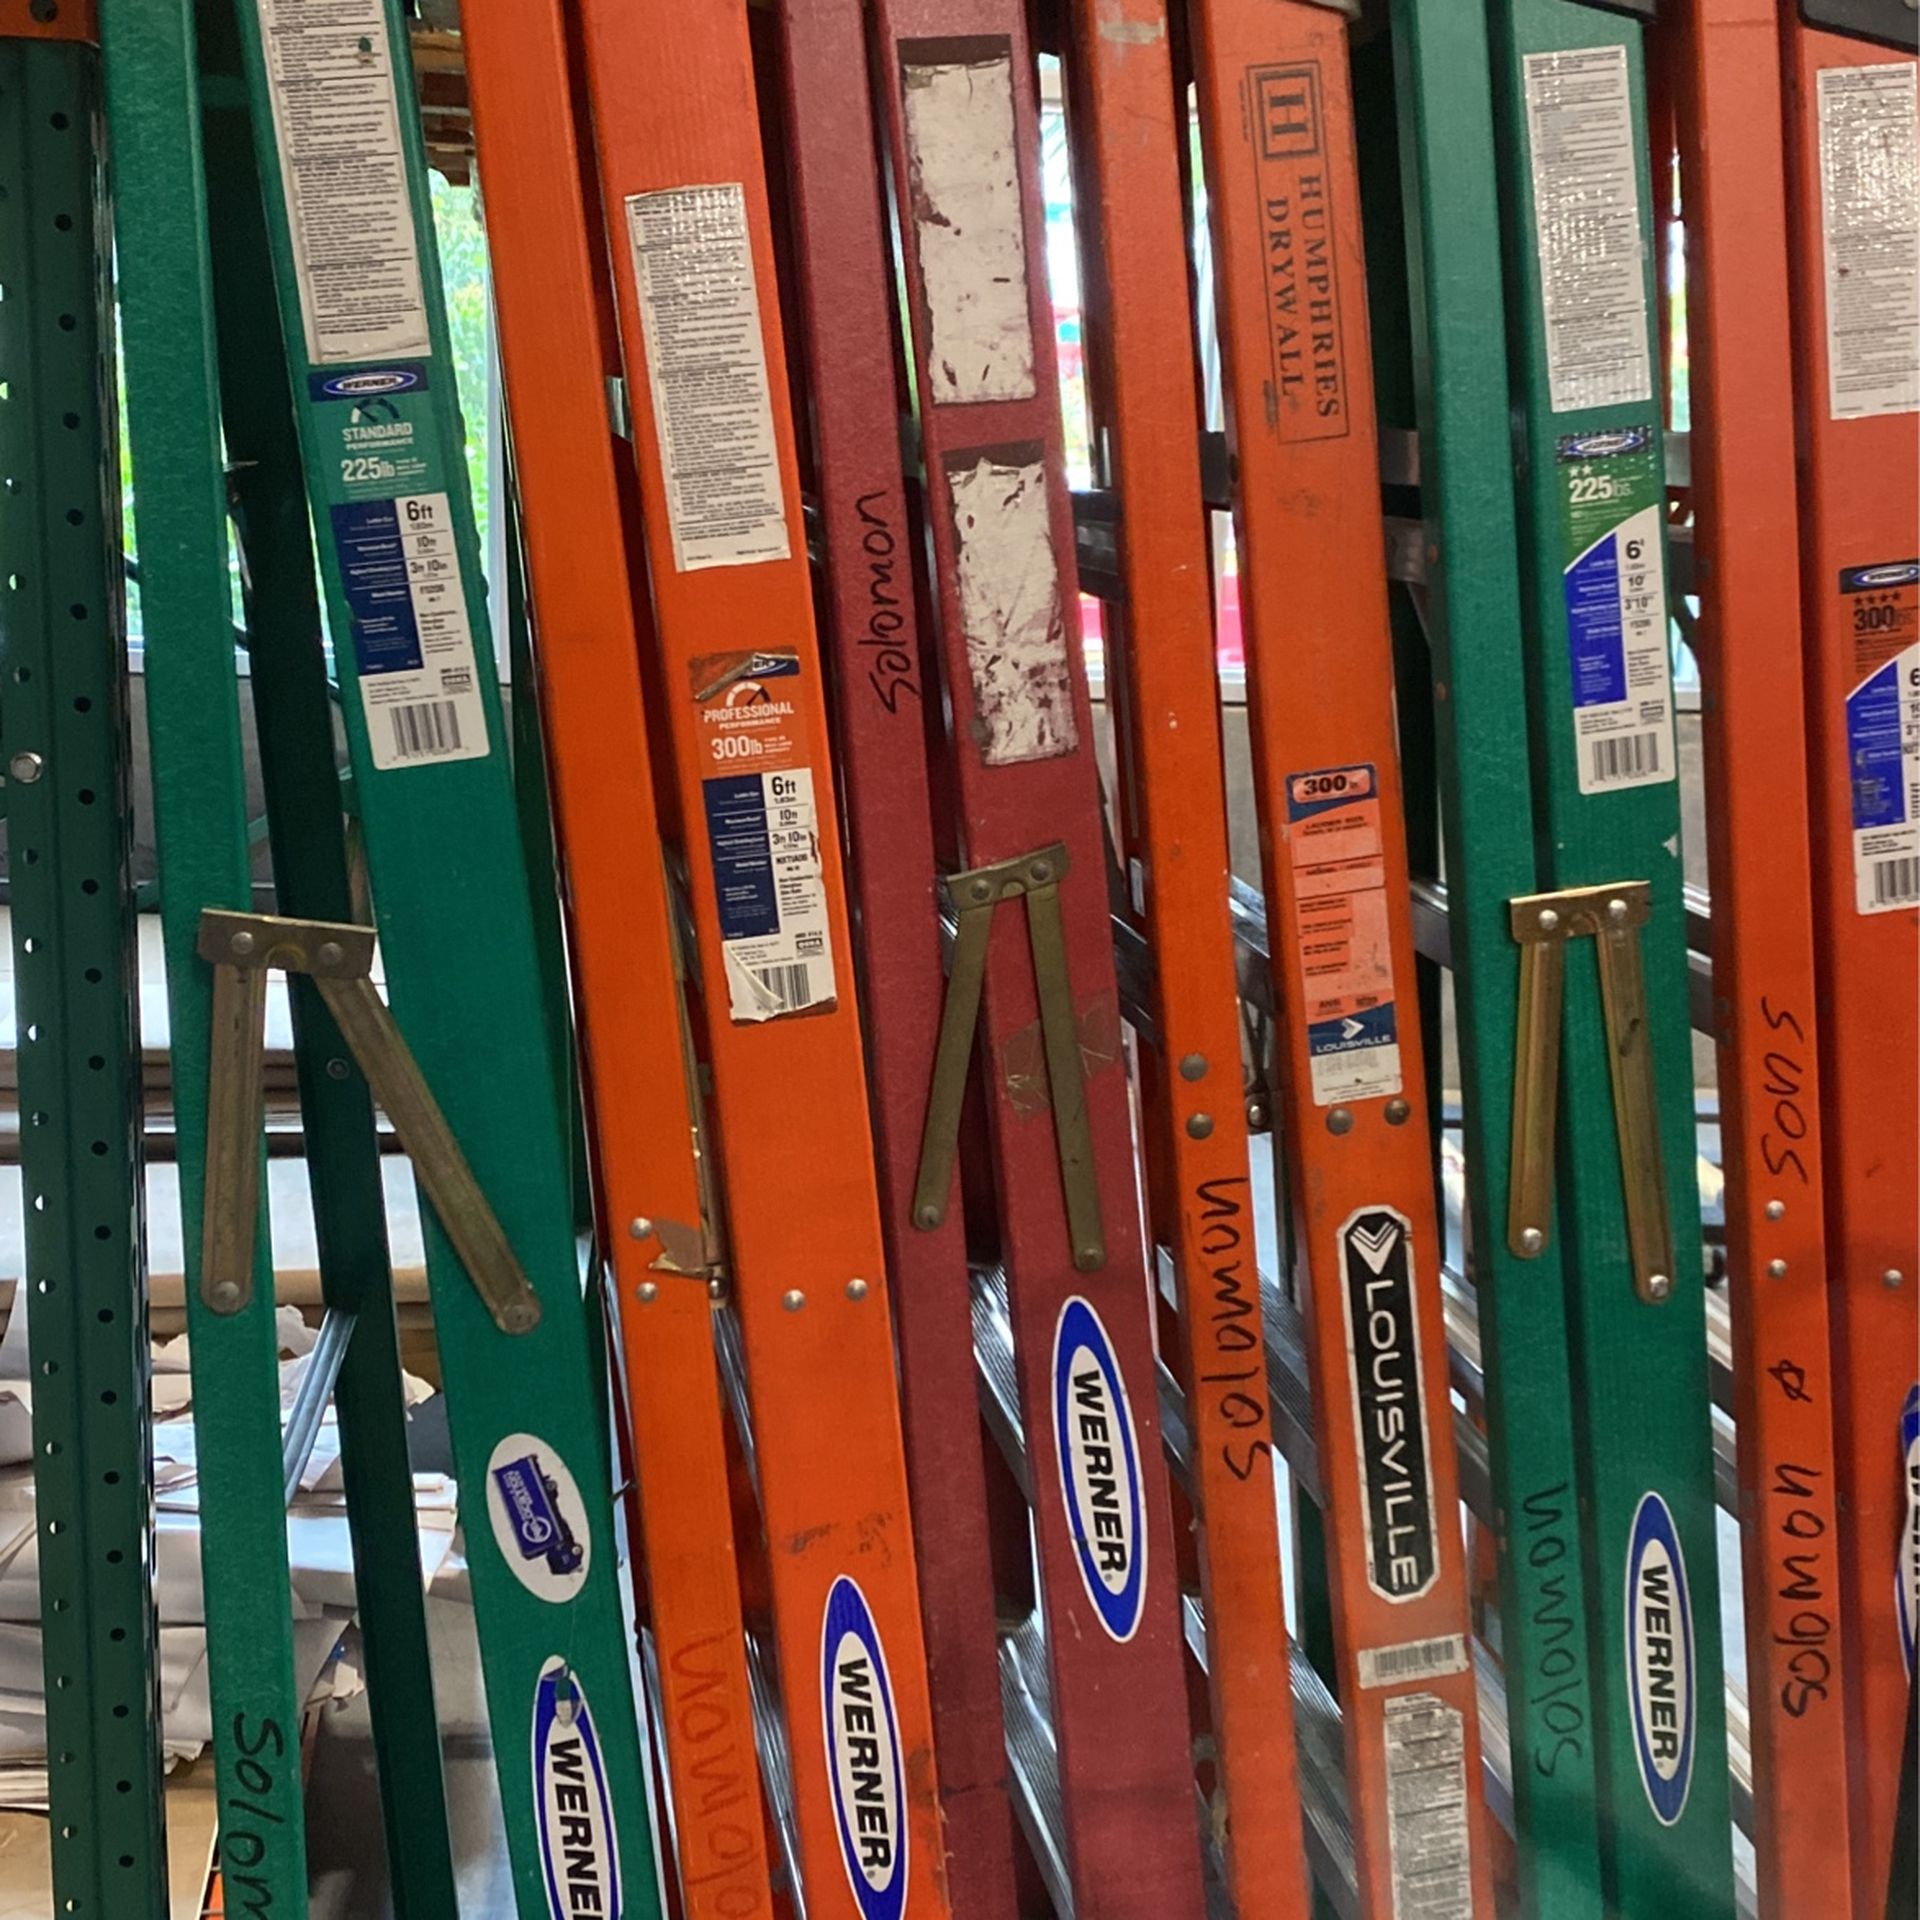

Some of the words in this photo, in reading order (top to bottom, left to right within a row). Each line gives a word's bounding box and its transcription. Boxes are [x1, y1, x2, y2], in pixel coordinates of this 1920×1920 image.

[1266, 197, 1305, 397] DRYWALL
[1299, 172, 1340, 417] HUMPHRIES
[342, 422, 414, 442] STANDARD
[406, 500, 434, 521] 6ft
[855, 490, 922, 715] Solomon
[704, 701, 795, 723] PROFESSIONAL
[772, 776, 796, 796] 6ft
[1304, 774, 1348, 796] 300
[1316, 1034, 1392, 1054] LOUISVILLE
[1073, 1368, 1127, 1581] WERNER
[1364, 1280, 1419, 1591] LOUISVILLE
[1522, 1481, 1584, 1778] Solomon
[1642, 1564, 1679, 1762] WERNER
[1773, 1462, 1832, 1719] Solomon
[549, 1737, 604, 1920] WERNE
[838, 1657, 892, 1870] WERNER
